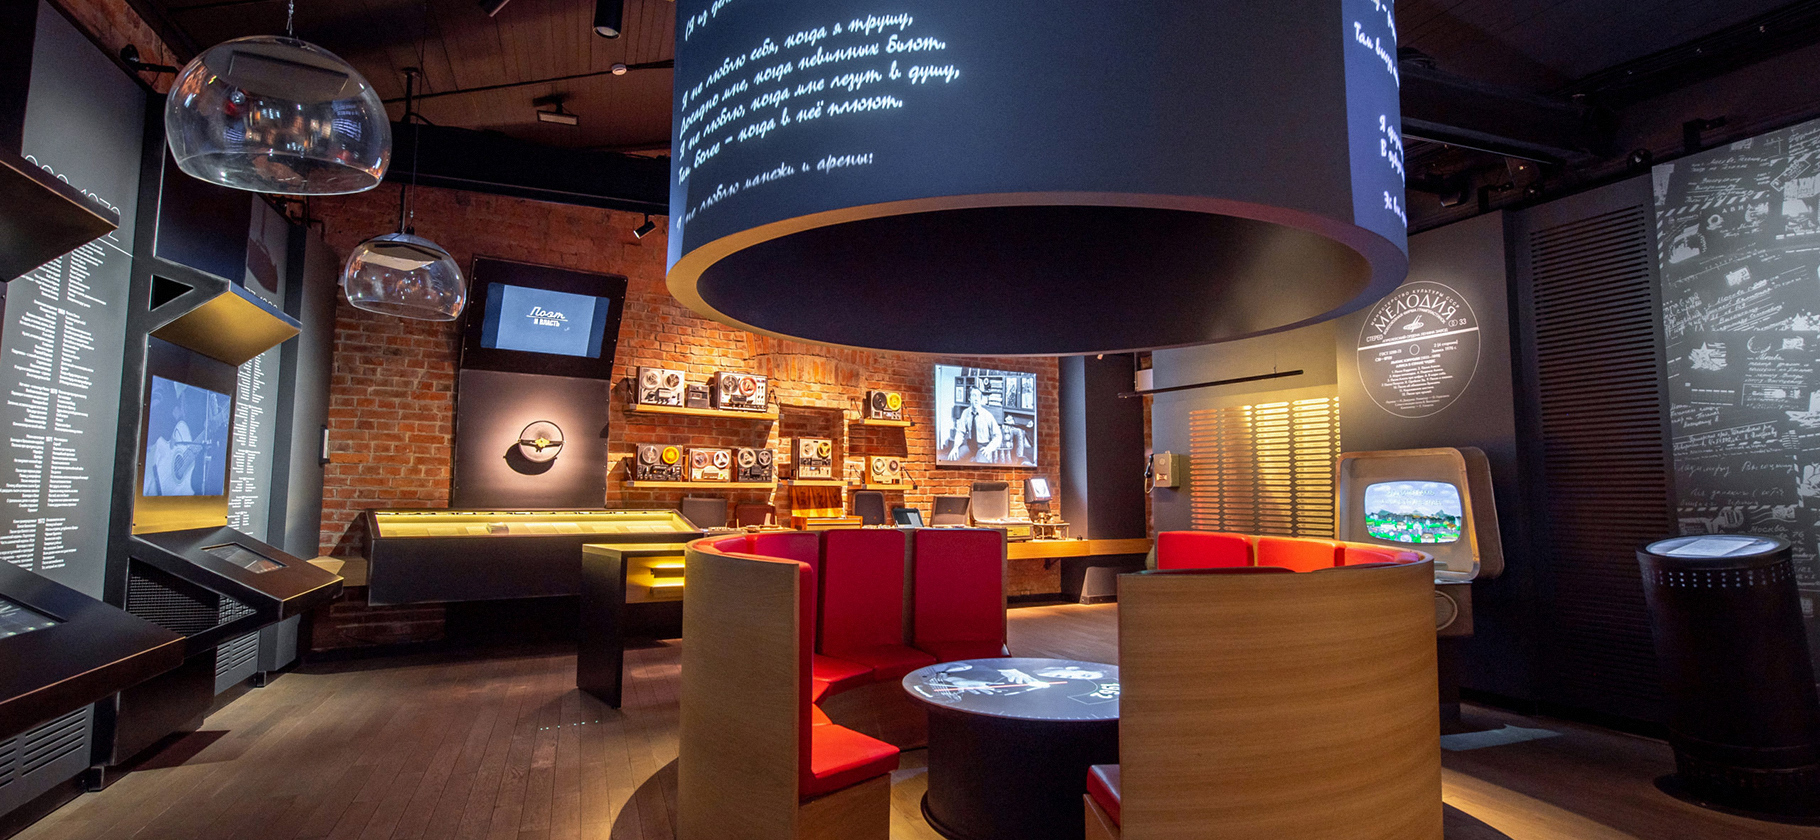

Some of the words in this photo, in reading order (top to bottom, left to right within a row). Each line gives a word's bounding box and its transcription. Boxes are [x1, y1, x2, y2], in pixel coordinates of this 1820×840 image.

[681, 90, 688, 112] Я
[690, 81, 703, 100] не
[705, 53, 746, 88] люблю
[750, 37, 779, 60] себя,
[784, 26, 827, 48] когда
[832, 22, 843, 36] я
[848, 12, 914, 36] трушу,
[679, 93, 719, 140] Досадно
[721, 79, 748, 101] мне,
[753, 61, 794, 85] когда
[798, 42, 880, 71] невинных
[679, 139, 686, 161] Я
[687, 131, 700, 150] не
[703, 104, 746, 138] люблю,
[750, 87, 790, 112] когда
[794, 78, 825, 97] мне
[830, 68, 882, 92] лезут
[888, 59, 902, 80] в
[908, 64, 960, 85] душу,
[693, 142, 720, 169] более
[737, 117, 777, 142] когда
[780, 106, 791, 126] в
[796, 99, 824, 123] неё
[827, 94, 903, 117] плюют.
[685, 207, 697, 224] не
[699, 183, 740, 213] люблю
[742, 161, 796, 190] манежи
[801, 161, 811, 173] и
[529, 306, 566, 320] Поэт
[1374, 294, 1457, 333] МЕЛОДИЯ
[1412, 288, 1445, 298] КУЛЬТУРЫ
[1445, 296, 1460, 308] СССР
[1459, 317, 1467, 326] 33
[1366, 334, 1384, 342] СТЕРЕО
